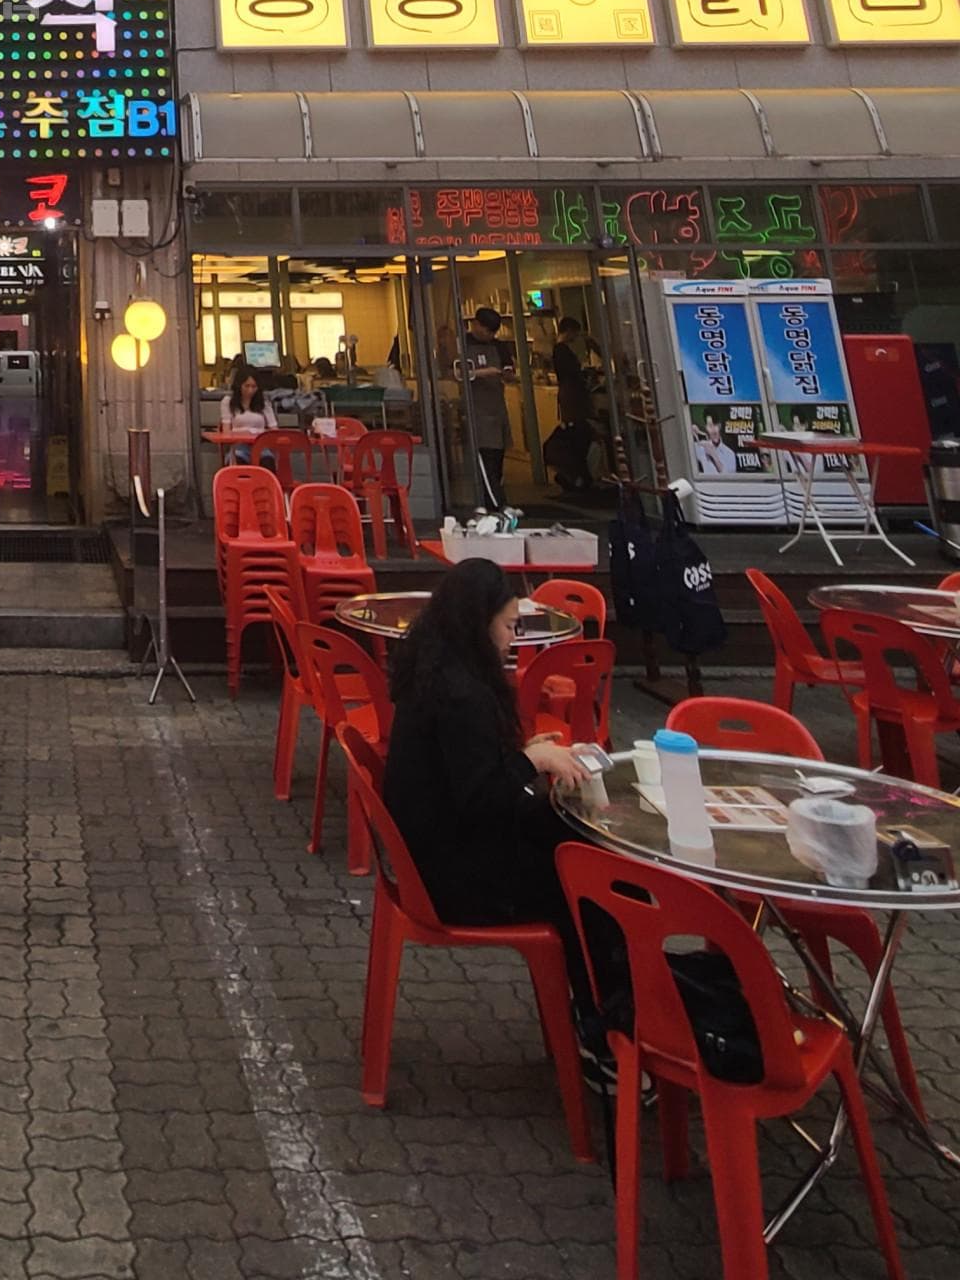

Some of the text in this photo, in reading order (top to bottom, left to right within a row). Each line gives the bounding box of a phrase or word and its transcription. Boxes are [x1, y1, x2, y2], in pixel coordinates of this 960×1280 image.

[128, 99, 177, 138] B1
[695, 305, 735, 396] 동명닭집
[780, 304, 820, 396] 동명닭집
[737, 453, 761, 468] TERRA
